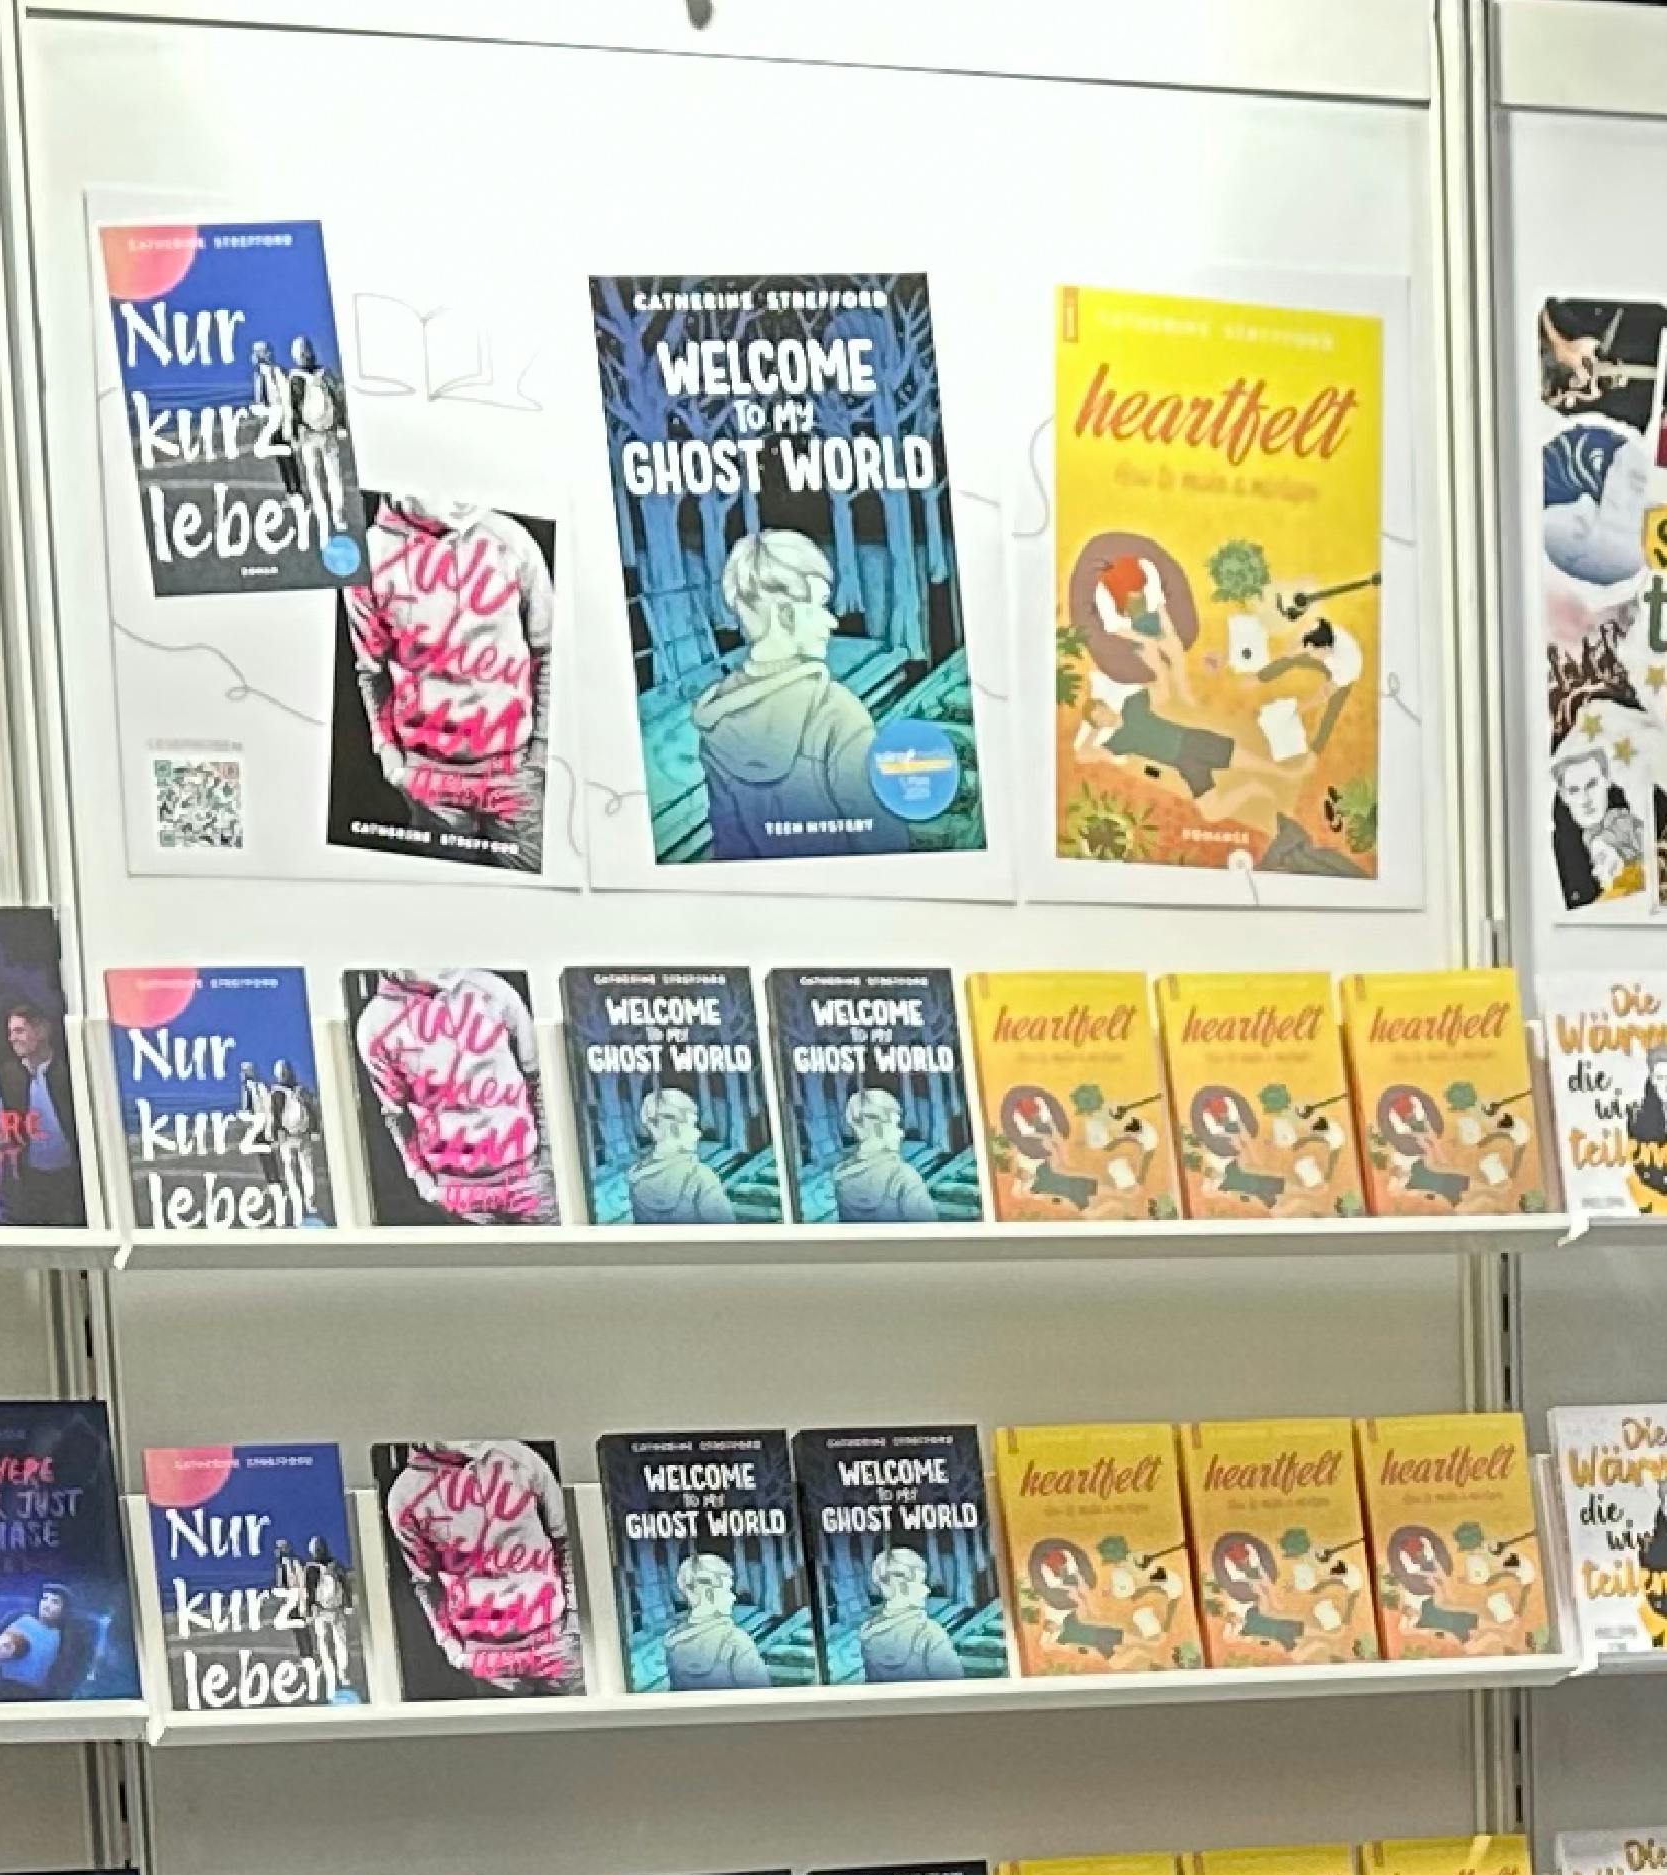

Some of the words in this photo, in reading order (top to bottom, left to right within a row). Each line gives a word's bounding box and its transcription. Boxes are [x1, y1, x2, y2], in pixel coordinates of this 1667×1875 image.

[120, 301, 246, 367] Nur
[657, 339, 876, 395] WELCOME
[132, 390, 292, 469] kurz
[1074, 362, 1358, 466] heartfelt
[622, 438, 764, 495] GHOST
[780, 435, 934, 492] WORLD
[605, 996, 721, 1028] WELCOME
[992, 1004, 1138, 1049] heartfelt
[1610, 982, 1661, 1017] Die
[131, 1028, 236, 1083] Nur
[587, 1044, 664, 1075] GHOST
[669, 1043, 752, 1073] WORLD
[139, 1101, 271, 1162] kurz
[1019, 1455, 1164, 1499] heartfelt
